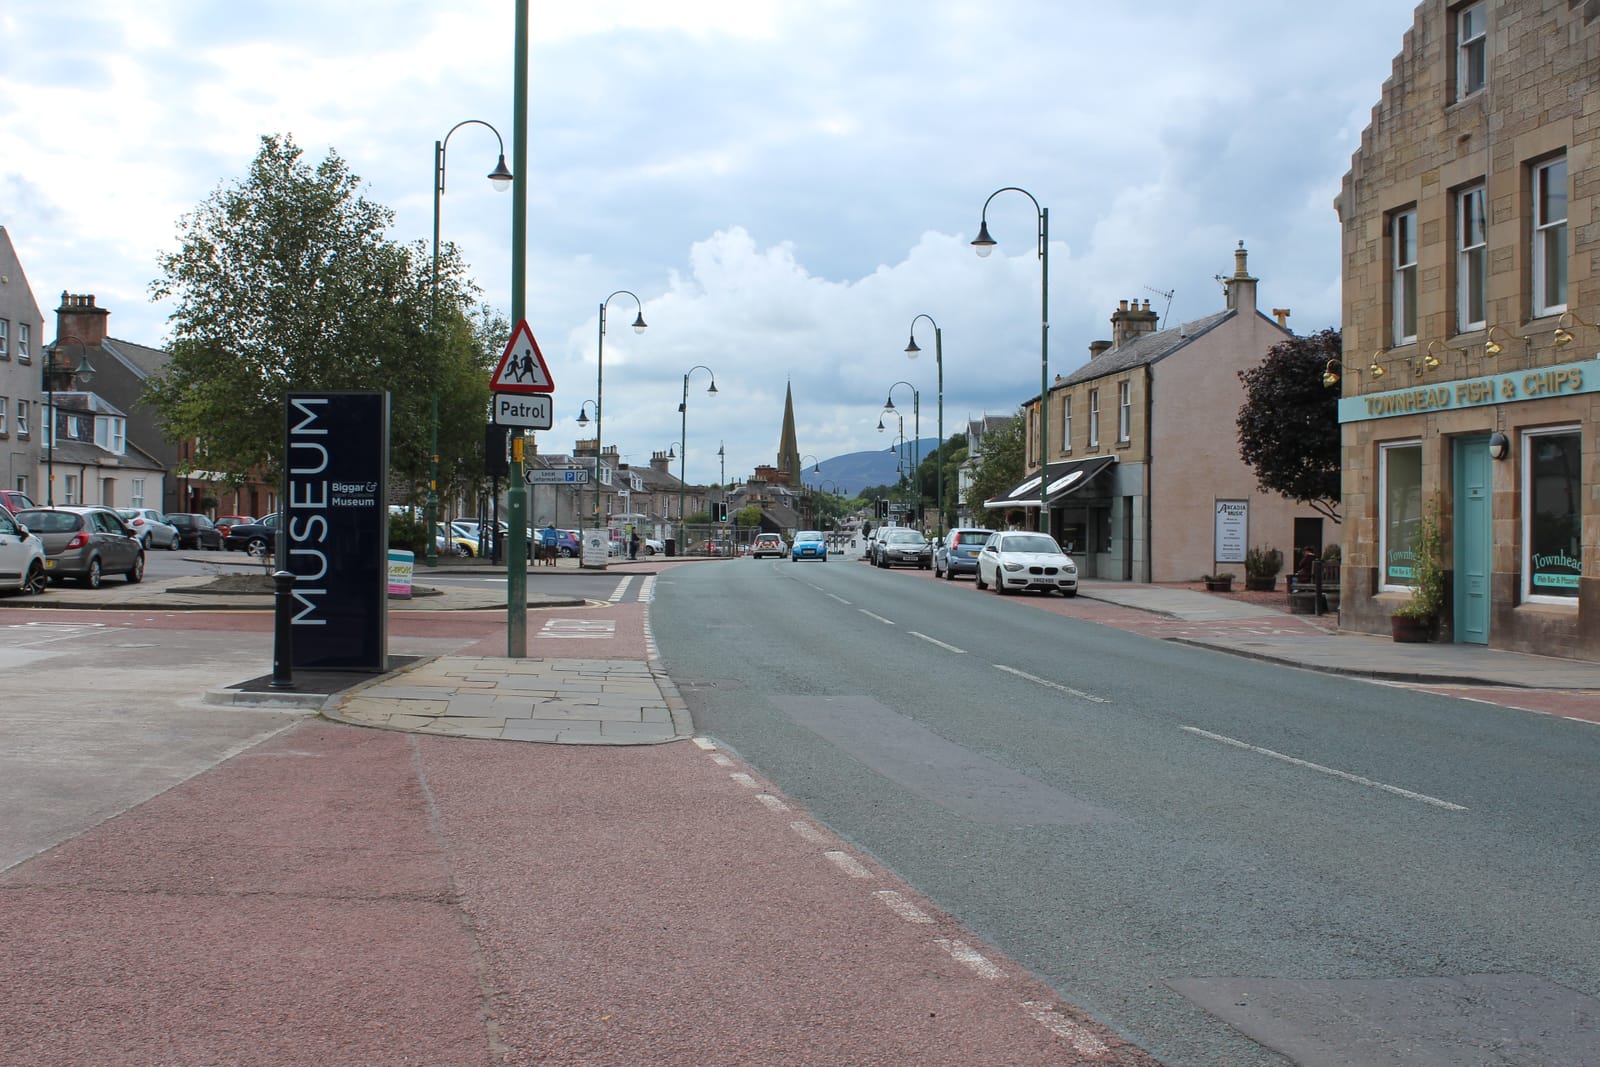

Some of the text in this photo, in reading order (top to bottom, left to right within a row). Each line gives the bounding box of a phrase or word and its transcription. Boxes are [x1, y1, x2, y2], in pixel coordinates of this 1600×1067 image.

[1364, 367, 1583, 415] TOWNHEAD FISH & CHIPS
[501, 401, 545, 419] Patrol
[332, 481, 378, 494] Biggar &
[332, 497, 375, 506] Museum
[1217, 503, 1246, 514] ARCADIA
[290, 398, 328, 625] MUSEUM
[1388, 546, 1418, 563] Townhe
